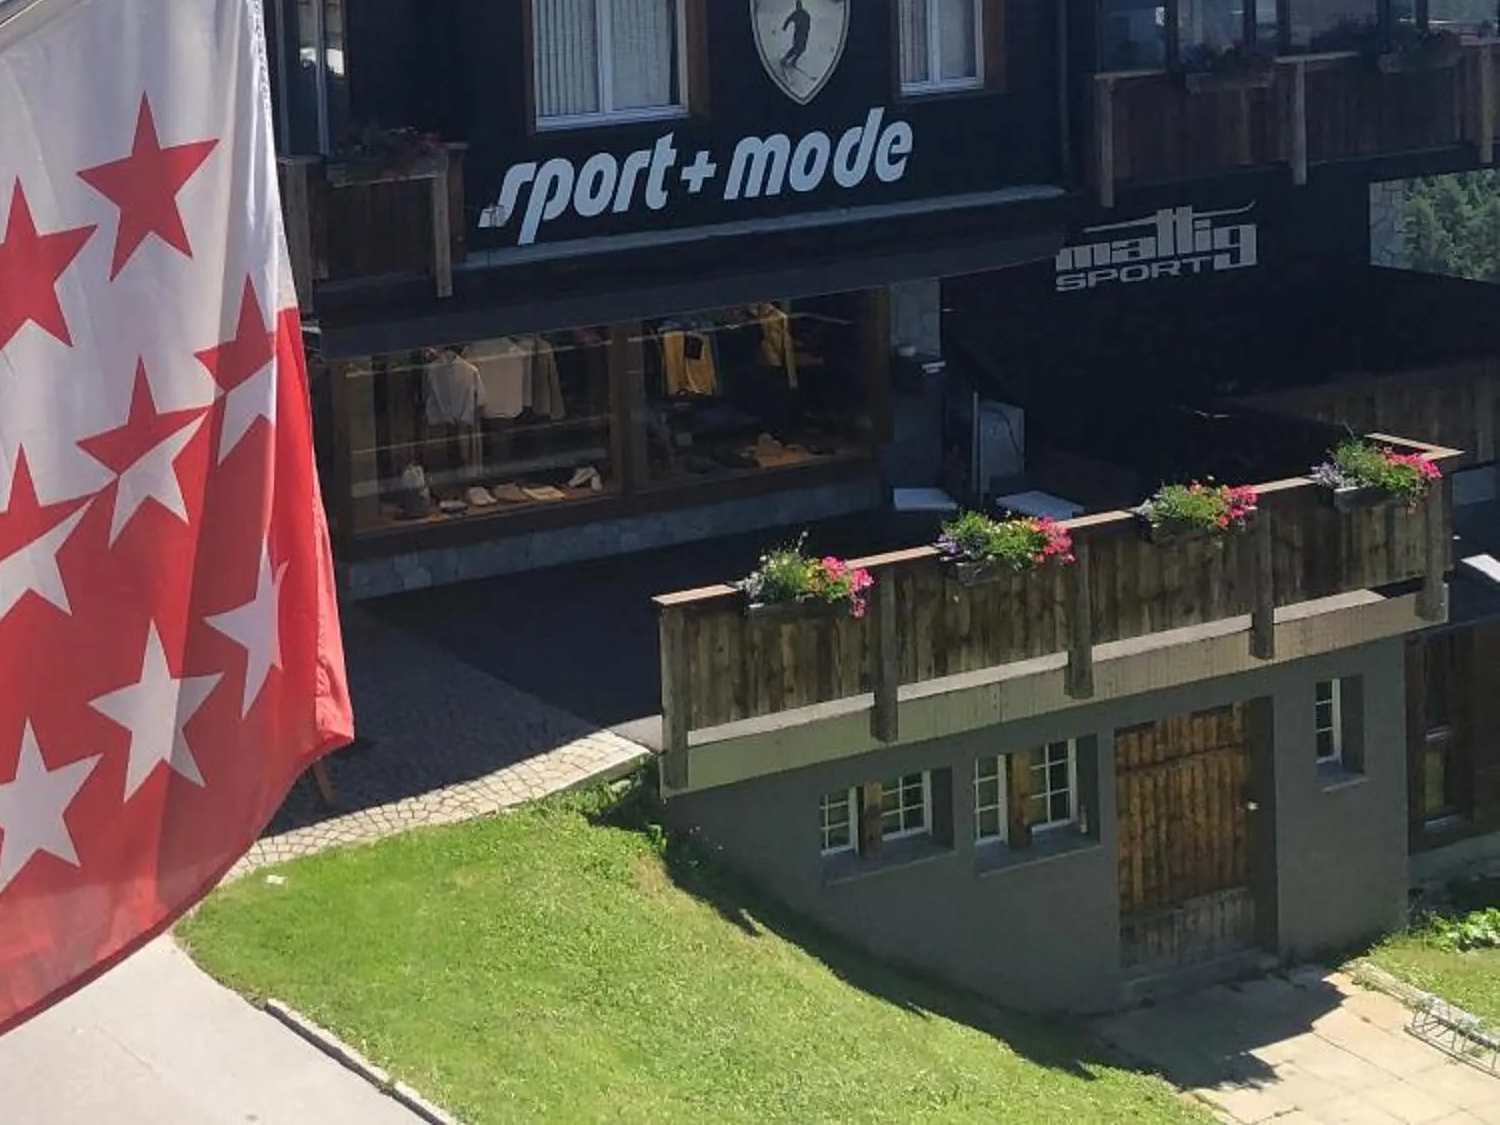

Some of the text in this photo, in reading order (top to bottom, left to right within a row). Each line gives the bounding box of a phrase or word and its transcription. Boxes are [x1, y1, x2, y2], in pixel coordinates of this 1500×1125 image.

[477, 130, 680, 246] sport
[723, 106, 914, 200] mode
[1055, 203, 1258, 271] mattig
[1055, 255, 1213, 292] SPORT
